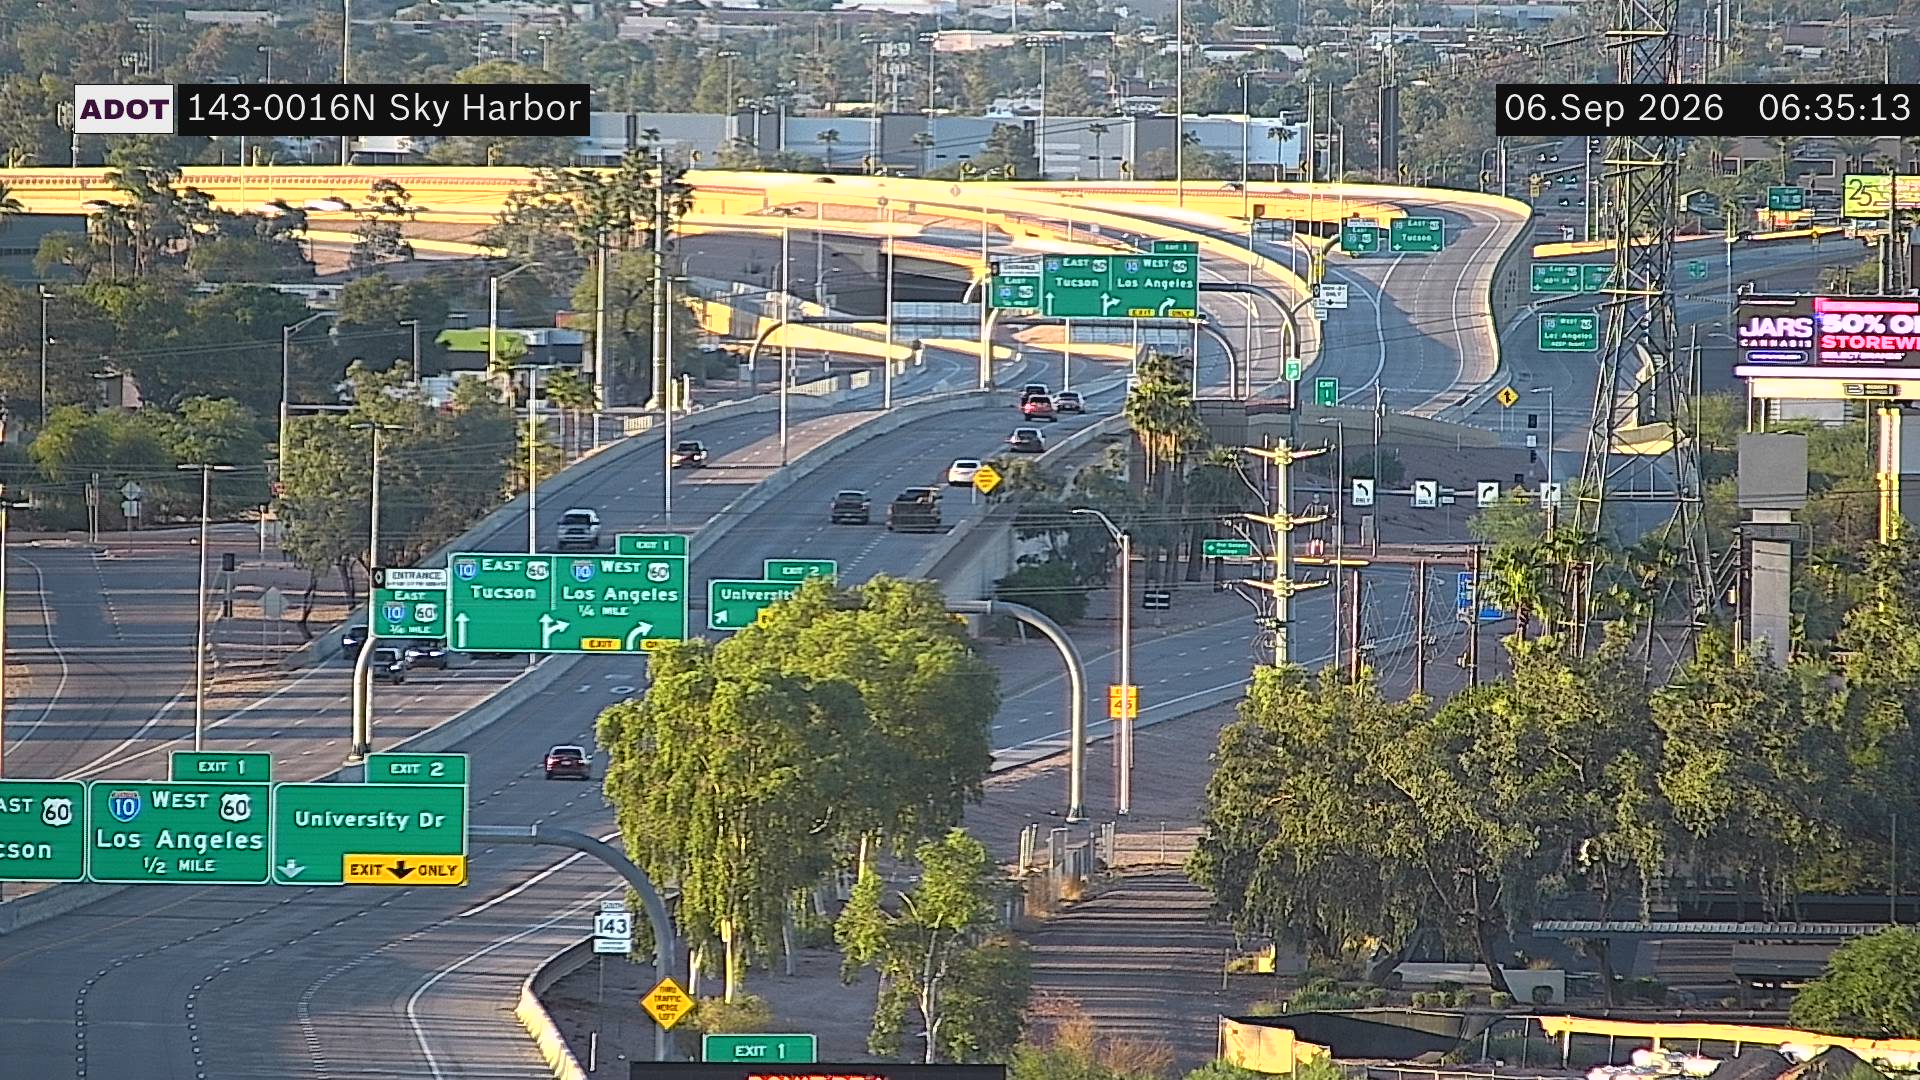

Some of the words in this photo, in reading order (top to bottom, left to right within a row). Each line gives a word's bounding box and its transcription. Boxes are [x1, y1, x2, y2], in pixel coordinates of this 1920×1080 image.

[1407, 219, 1425, 227] EAST
[1402, 234, 1432, 242] Tucson
[1063, 257, 1090, 267] EAST
[1143, 259, 1170, 268] WEST
[1055, 277, 1099, 288] Tucson
[1117, 278, 1139, 288] Los
[1144, 278, 1194, 291] Angeles
[1740, 317, 1813, 337] JARS
[1821, 313, 1886, 334] 50%
[1561, 332, 1593, 341] Angeles
[1740, 339, 1812, 347] CANNABIS
[635, 541, 658, 549] EXIT
[663, 540, 670, 551] 1
[459, 564, 475, 577] 10
[482, 558, 522, 571] EAST
[528, 564, 546, 577] 60
[575, 566, 591, 578] 10
[600, 560, 641, 573] WEST
[649, 566, 667, 578] 60
[809, 566, 820, 577] 2
[392, 571, 443, 580] ENTRANCE
[394, 590, 427, 601] EAST
[470, 584, 537, 599] Tucson
[562, 585, 596, 600] Los
[603, 587, 678, 605] Angeles
[720, 588, 797, 600] Universit
[387, 606, 403, 619] 10
[416, 607, 434, 619] 60
[601, 606, 630, 616] MILE
[588, 639, 613, 648] EXIT
[198, 761, 229, 772] EXIT
[237, 760, 246, 775] 1
[390, 763, 422, 774] EXIT
[430, 761, 445, 778] 2
[115, 798, 135, 816] 10
[151, 790, 210, 809] WEST
[223, 804, 248, 817] 60
[45, 803, 69, 821] 60
[294, 810, 410, 833] University
[418, 812, 447, 829] Dr
[96, 829, 142, 849] Los
[156, 829, 264, 855] Angeles
[143, 856, 167, 875] 1/2
[178, 859, 216, 872] MILE
[350, 863, 382, 877] EXIT
[418, 864, 458, 878] ONLY
[598, 918, 629, 935] 143
[653, 995, 682, 1003] TRAFFIC
[656, 1004, 678, 1012] MERGE
[658, 1013, 675, 1021] LEFT
[734, 1045, 767, 1058] EXIT
[777, 1043, 786, 1060] 1
